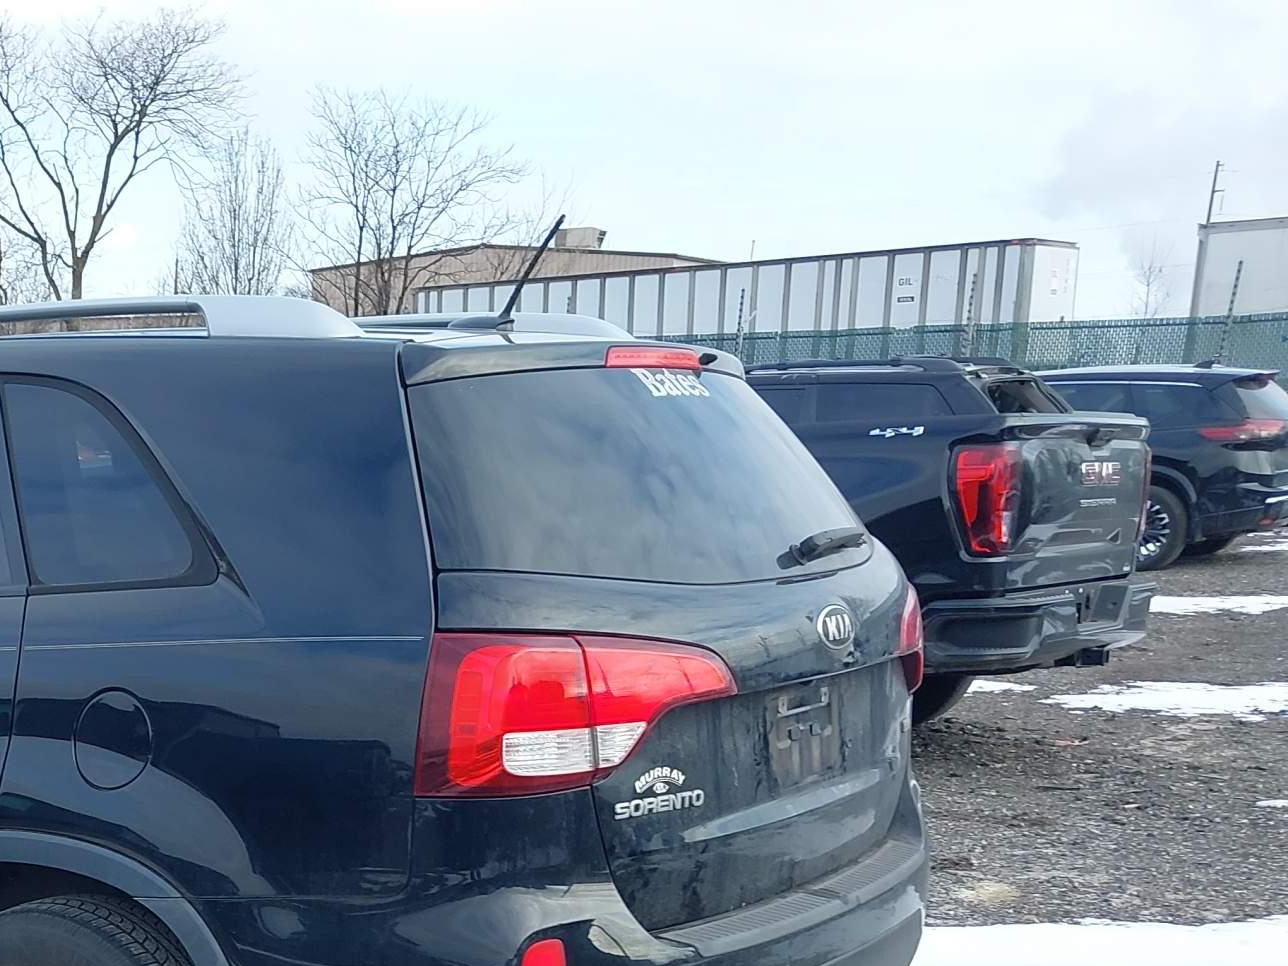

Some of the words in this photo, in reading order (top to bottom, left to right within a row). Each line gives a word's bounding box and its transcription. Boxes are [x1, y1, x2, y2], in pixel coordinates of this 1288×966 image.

[899, 277, 913, 287] GIL
[630, 368, 710, 397] Bates
[824, 613, 852, 641] KIA
[634, 766, 686, 793] MURRAY
[613, 789, 705, 820] SORENTO
